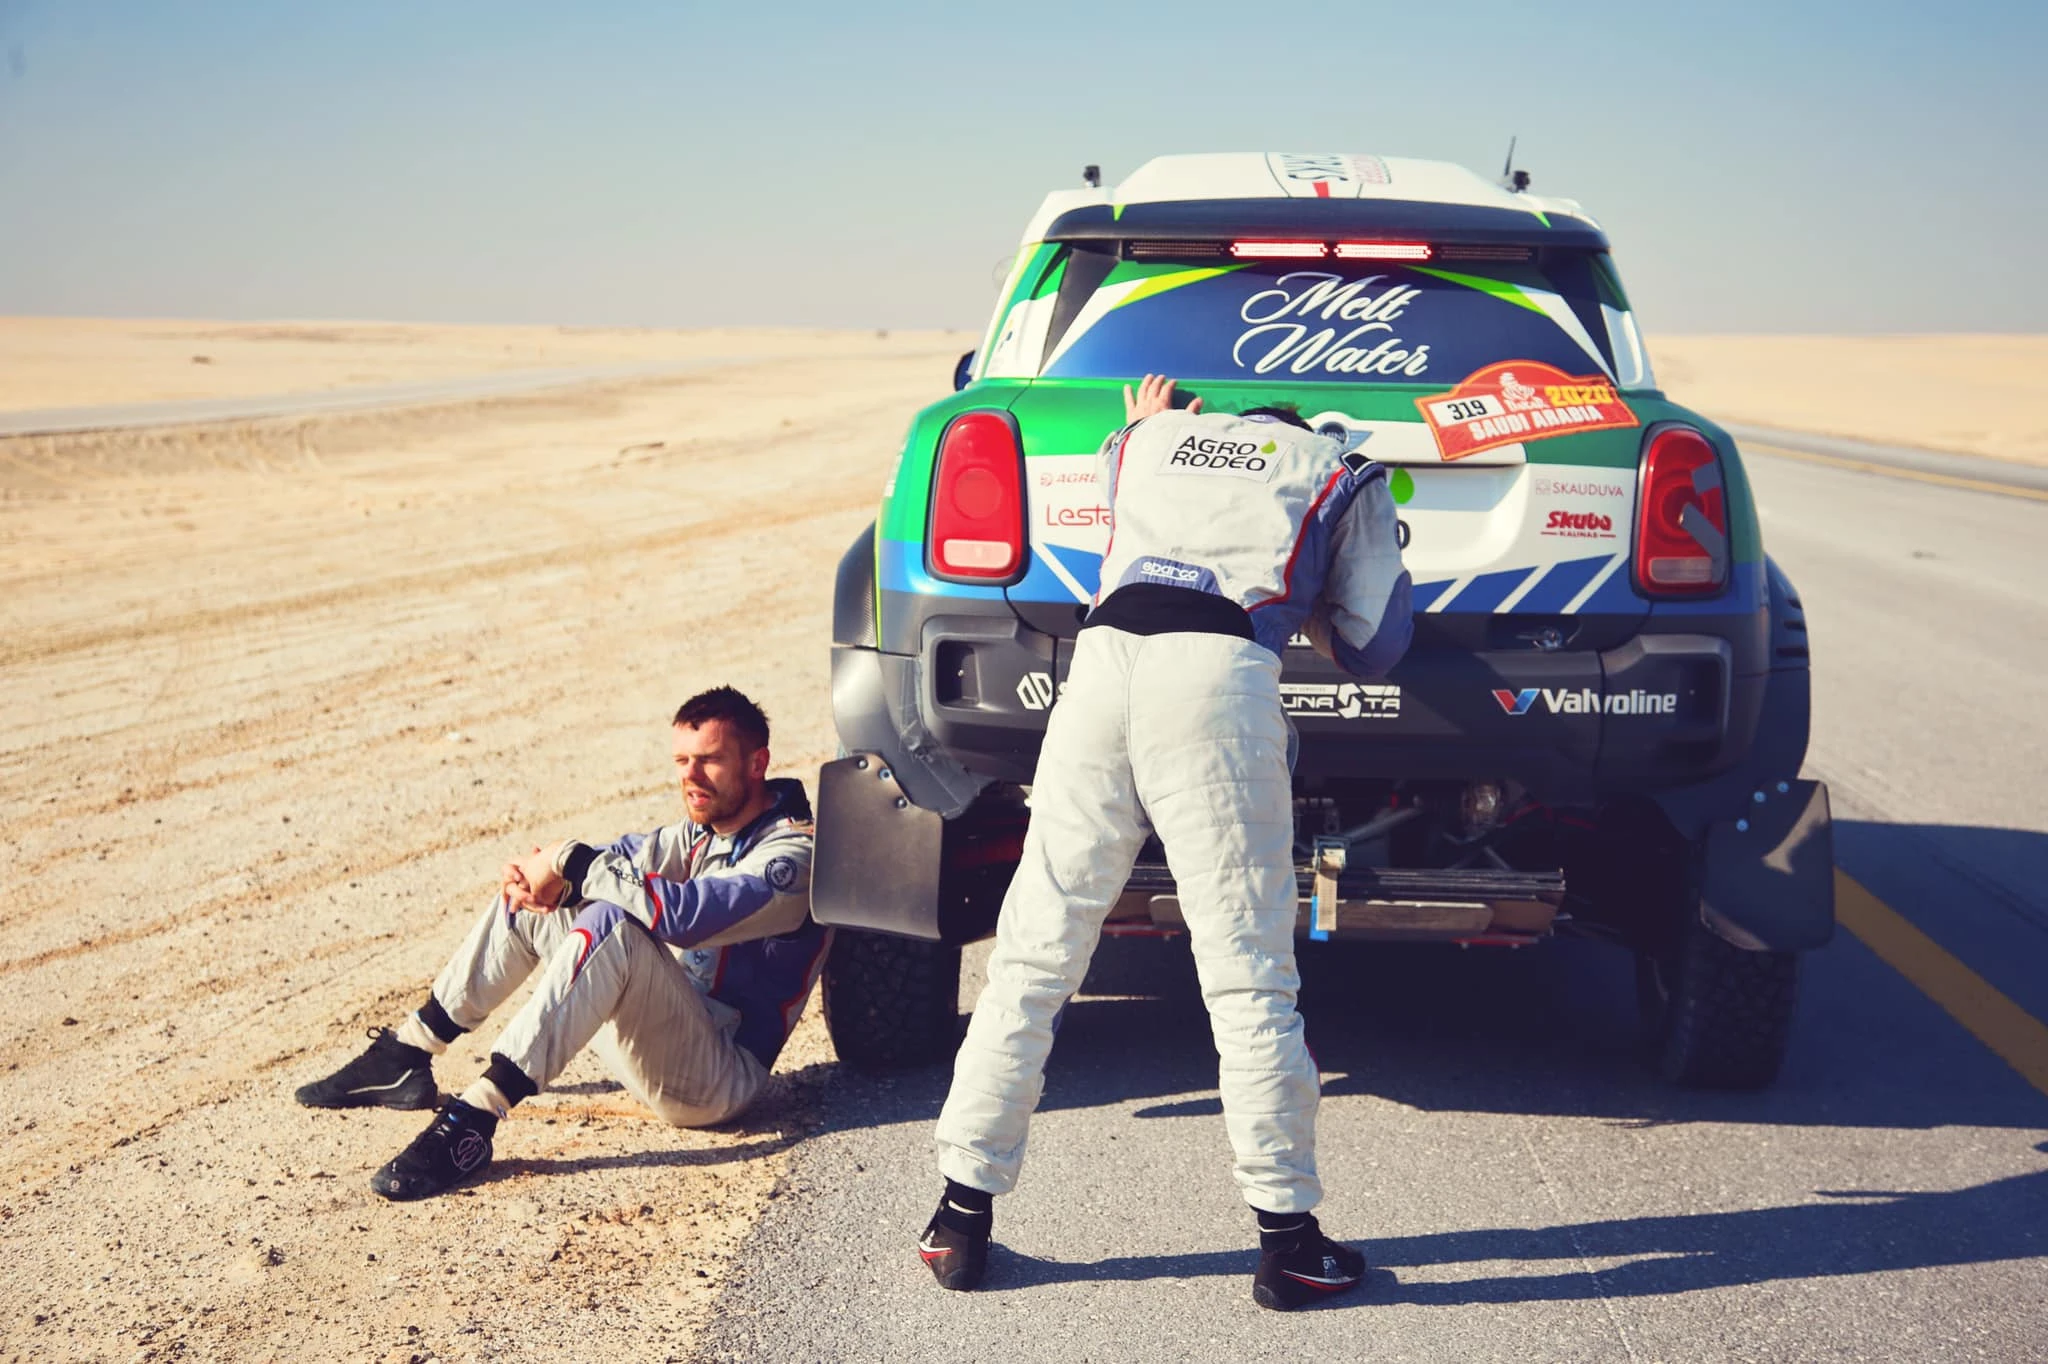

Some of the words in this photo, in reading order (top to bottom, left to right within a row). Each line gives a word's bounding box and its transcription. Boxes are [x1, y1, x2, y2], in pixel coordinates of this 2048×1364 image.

[1241, 271, 1423, 324] Melt
[1232, 322, 1431, 376] Water
[1544, 384, 1614, 408] 2020
[1447, 399, 1488, 421] 319
[1467, 412, 1531, 442] SAUDI
[1529, 404, 1604, 429] ARABIA
[1179, 435, 1257, 456] AGRO
[1170, 451, 1267, 472] RODEO
[1552, 481, 1625, 498] SKAUDUVA
[1141, 560, 1199, 582] sparco
[1541, 688, 1678, 716] Valvoline
